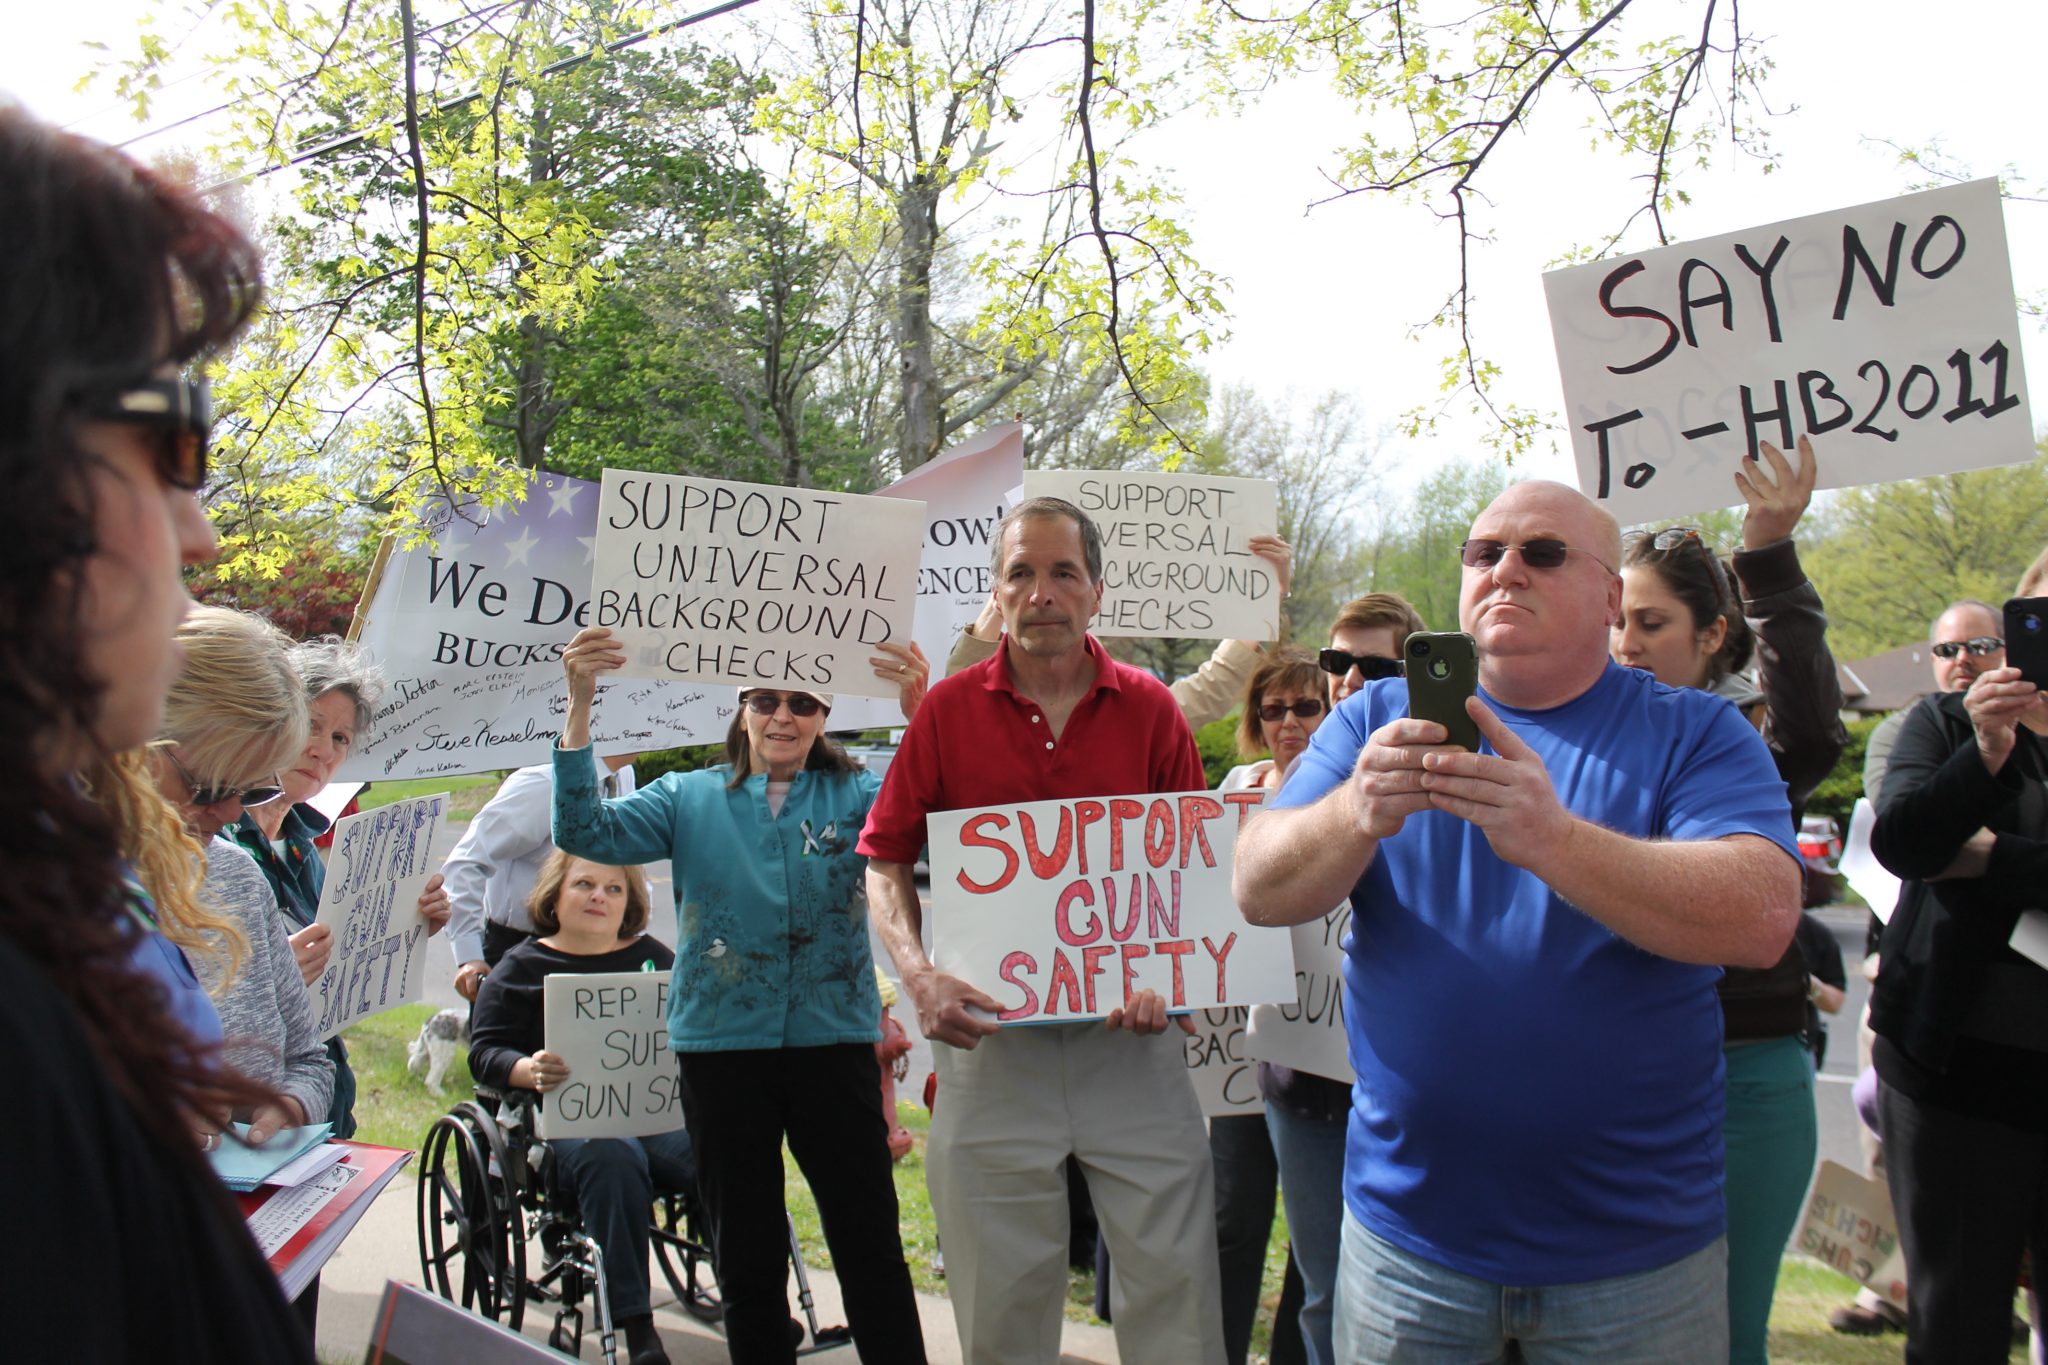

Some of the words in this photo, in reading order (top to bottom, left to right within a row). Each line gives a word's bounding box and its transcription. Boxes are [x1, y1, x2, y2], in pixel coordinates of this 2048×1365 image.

[1600, 235, 1790, 375] SAY
[1832, 214, 1967, 321] NO
[609, 480, 842, 544] SUPPORT
[922, 506, 1003, 548] OW!
[1079, 480, 1236, 520] SUPPORT
[1097, 521, 1253, 557] VERSAL
[427, 556, 507, 617] We
[633, 541, 896, 602] UNIVERSAL
[1104, 560, 1270, 600] CKGROUND
[598, 589, 892, 645] BACKGROUND
[432, 631, 568, 667] BUCKS
[666, 641, 834, 684] CHECKS
[332, 798, 442, 905] SUPPORT
[957, 792, 1264, 894] SUPPORT
[340, 880, 397, 961] GUN
[1055, 871, 1181, 946] GUN
[316, 924, 422, 1036] SAFETY
[575, 986, 642, 1020] REP.
[997, 931, 1238, 1021] SAFETY
[558, 1081, 632, 1122] GUN
